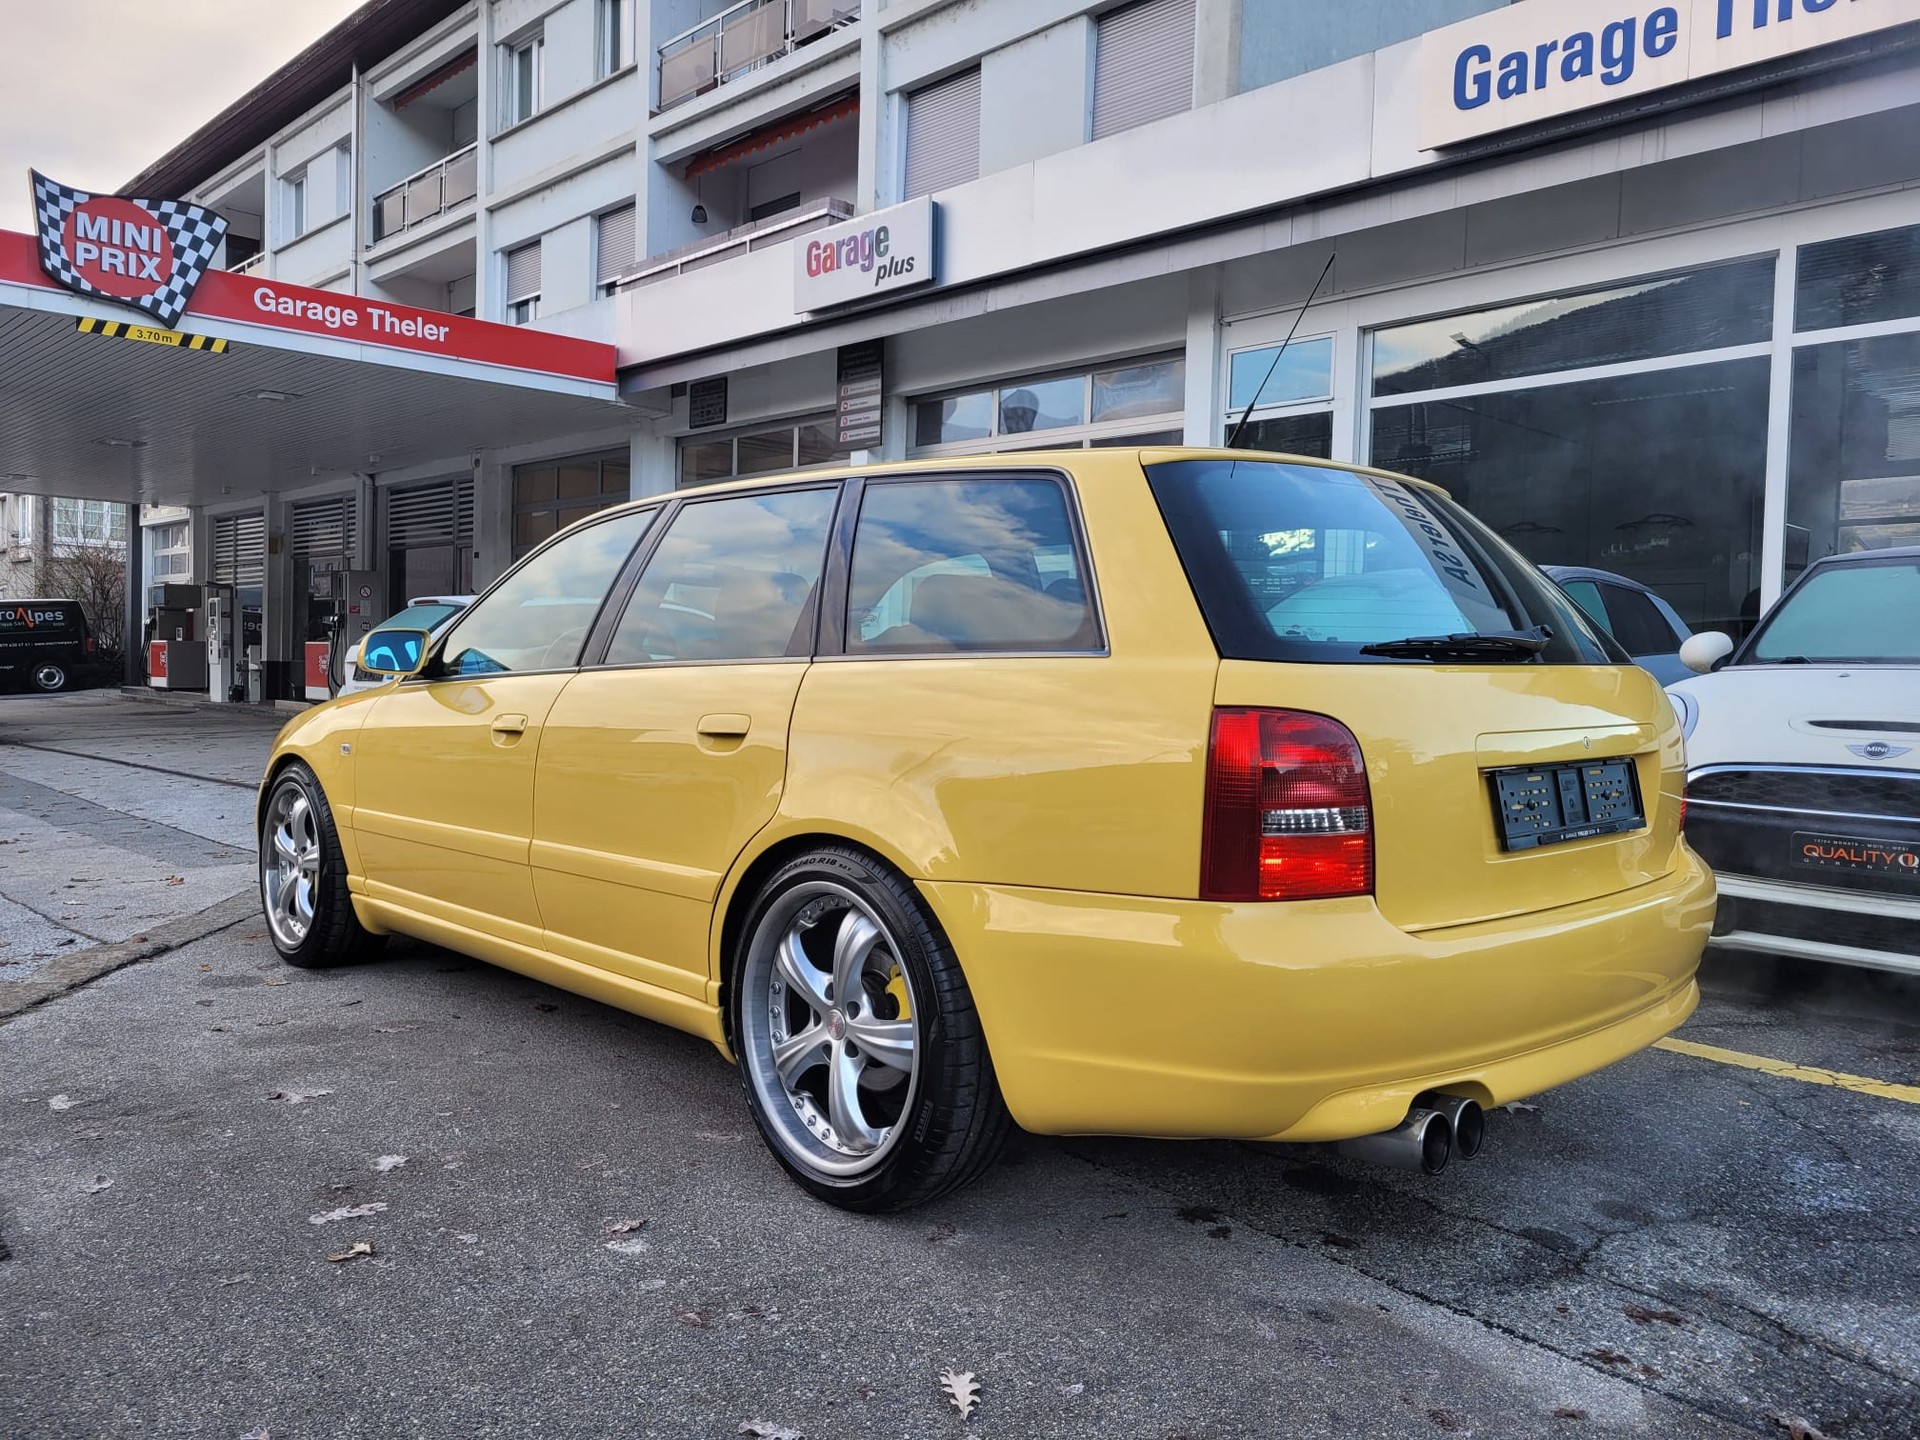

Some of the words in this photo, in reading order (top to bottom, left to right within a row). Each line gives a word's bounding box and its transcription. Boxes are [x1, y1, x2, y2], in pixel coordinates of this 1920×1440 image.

[1453, 7, 1678, 110] Garage
[76, 211, 161, 254] MINI
[806, 225, 890, 278] Garage
[76, 241, 162, 282] PRIX
[875, 256, 915, 287] plus
[253, 287, 358, 329] Garage
[366, 307, 449, 342] Theler
[1803, 844, 1896, 864] QUALITY
[1803, 858, 1919, 874] GARANTIE
